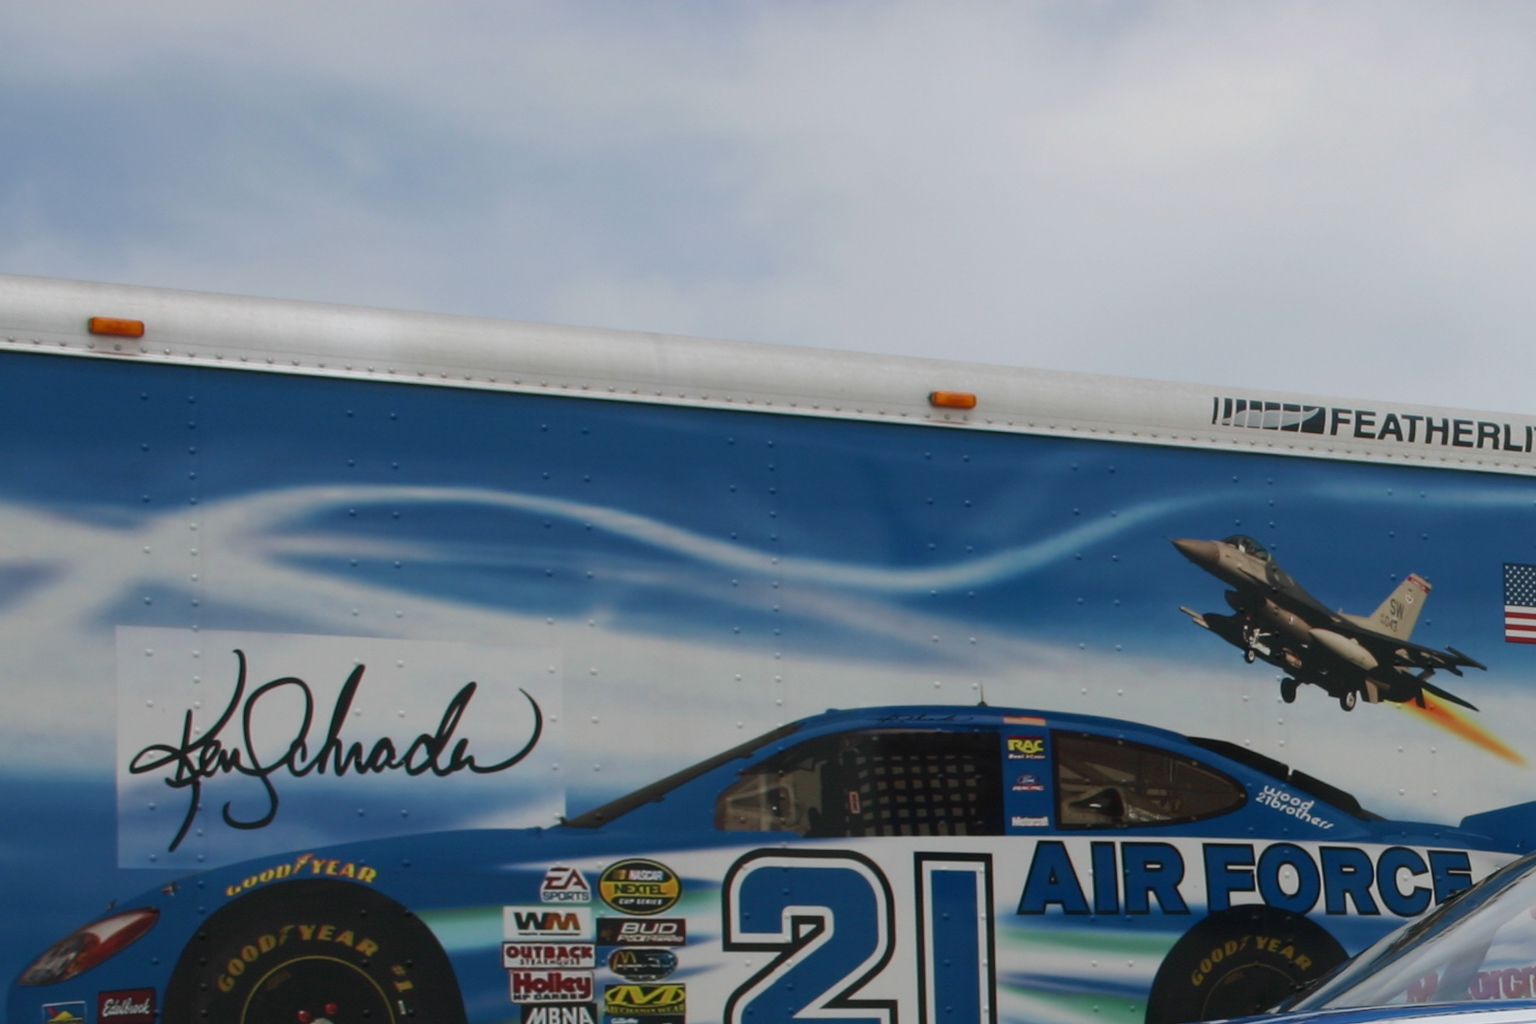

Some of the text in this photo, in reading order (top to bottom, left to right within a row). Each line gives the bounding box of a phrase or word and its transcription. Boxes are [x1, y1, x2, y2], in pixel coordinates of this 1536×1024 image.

[1007, 738, 1044, 754] RAC
[1263, 785, 1315, 811] wood
[543, 866, 589, 891] EA
[1016, 839, 1473, 917] AIR FORCE
[543, 891, 590, 901] SPORTS
[614, 883, 667, 895] NEXTEL
[513, 911, 582, 931] WM
[620, 922, 678, 934] BUD
[505, 945, 594, 959] OUTBACK
[513, 972, 592, 999] Holley
